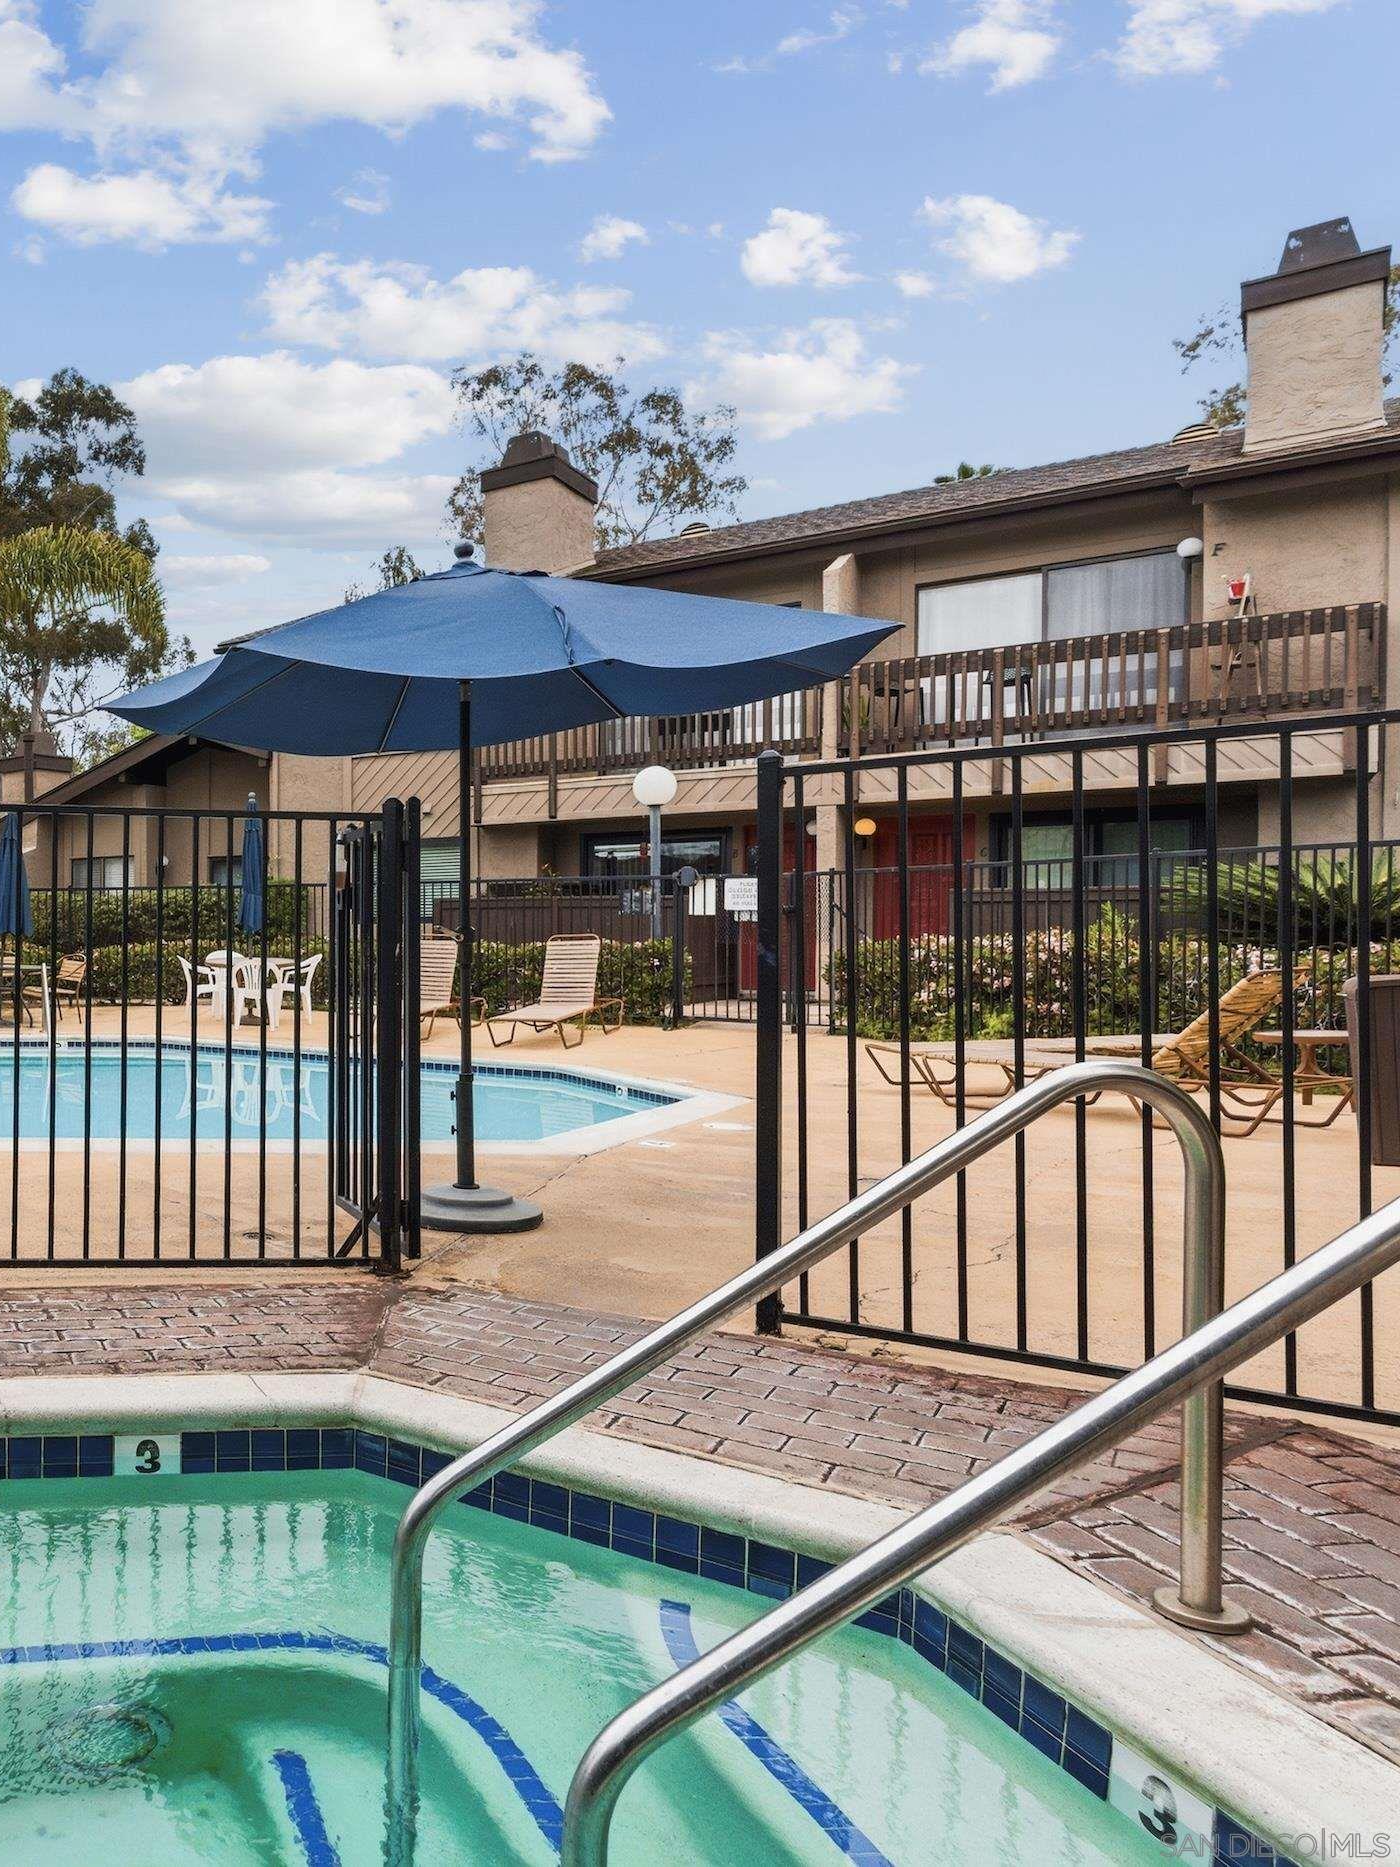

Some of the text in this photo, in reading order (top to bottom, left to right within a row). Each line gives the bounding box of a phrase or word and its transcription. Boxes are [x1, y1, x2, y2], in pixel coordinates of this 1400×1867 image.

[1211, 542, 1227, 557] F
[135, 1439, 161, 1474] 3
[1138, 1775, 1178, 1845] 3
